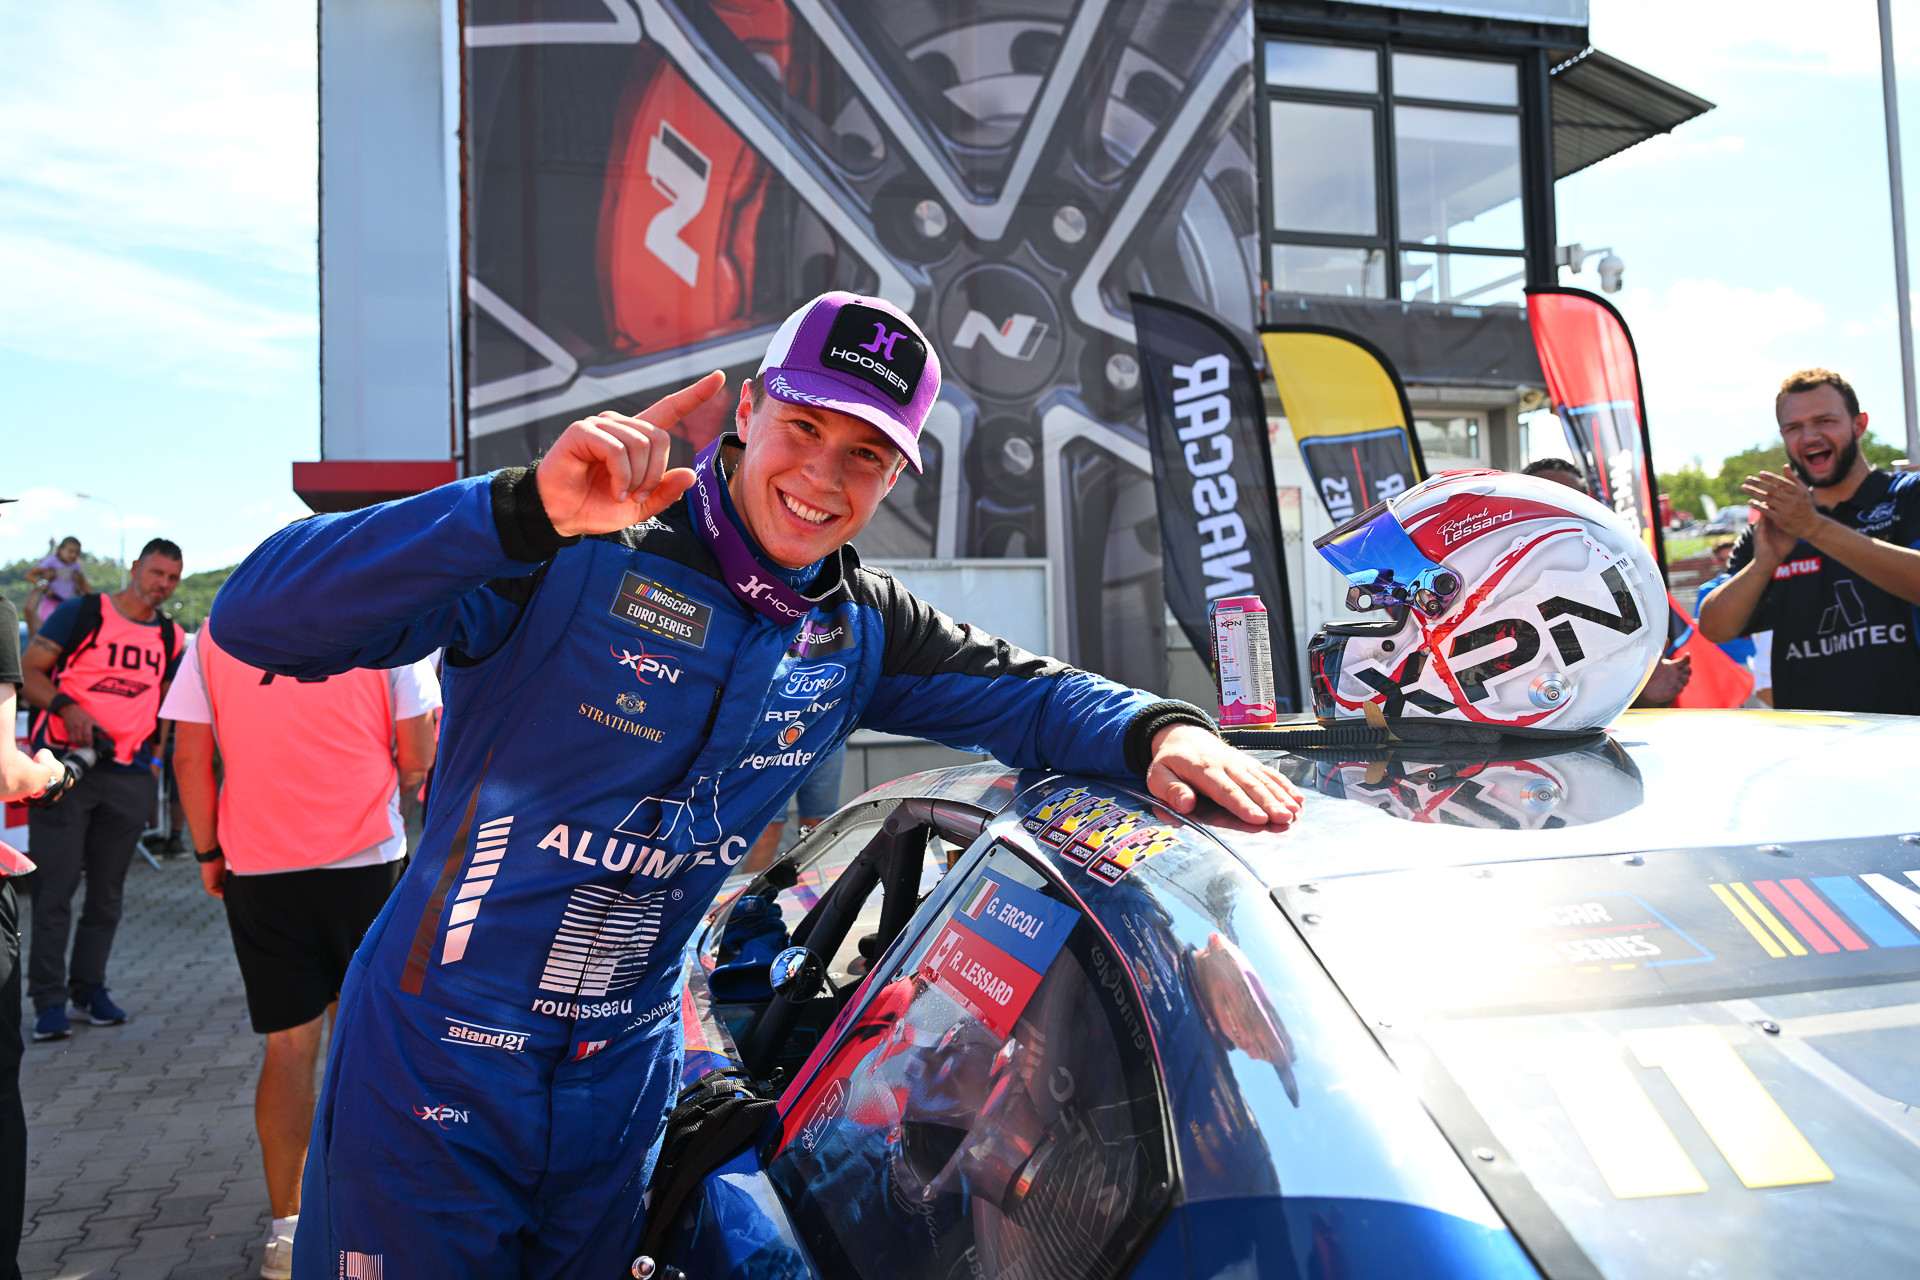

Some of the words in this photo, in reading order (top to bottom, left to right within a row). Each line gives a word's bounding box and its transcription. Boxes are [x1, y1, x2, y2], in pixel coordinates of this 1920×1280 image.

[830, 347, 908, 394] HOOSIER
[696, 474, 720, 539] HOOSIER
[1436, 507, 1489, 535] Raphael
[1445, 509, 1513, 546] Lessard
[650, 590, 696, 617] NASCAR
[764, 594, 810, 618] HOOS
[626, 603, 657, 624] EURO
[656, 615, 693, 638] SERIES
[1221, 620, 1242, 628] XPN
[793, 626, 844, 645] OSIER
[1354, 565, 1643, 717] XPN
[1786, 624, 1906, 660] ALUMITEC
[108, 643, 161, 676] 104
[618, 649, 681, 684] XPN
[785, 668, 838, 695] Ford
[578, 702, 666, 744] STRATHMORE
[764, 698, 842, 722] RAING
[739, 748, 816, 770] Permate
[986, 897, 1000, 917] G.
[997, 903, 1044, 939] ERCOLI
[1557, 935, 1662, 963] SERIES
[949, 950, 964, 971] R.
[960, 957, 1014, 1006] LESSARD
[531, 998, 633, 1020] rousseau
[448, 1026, 526, 1051] stand21
[422, 1106, 469, 1124] XPN
